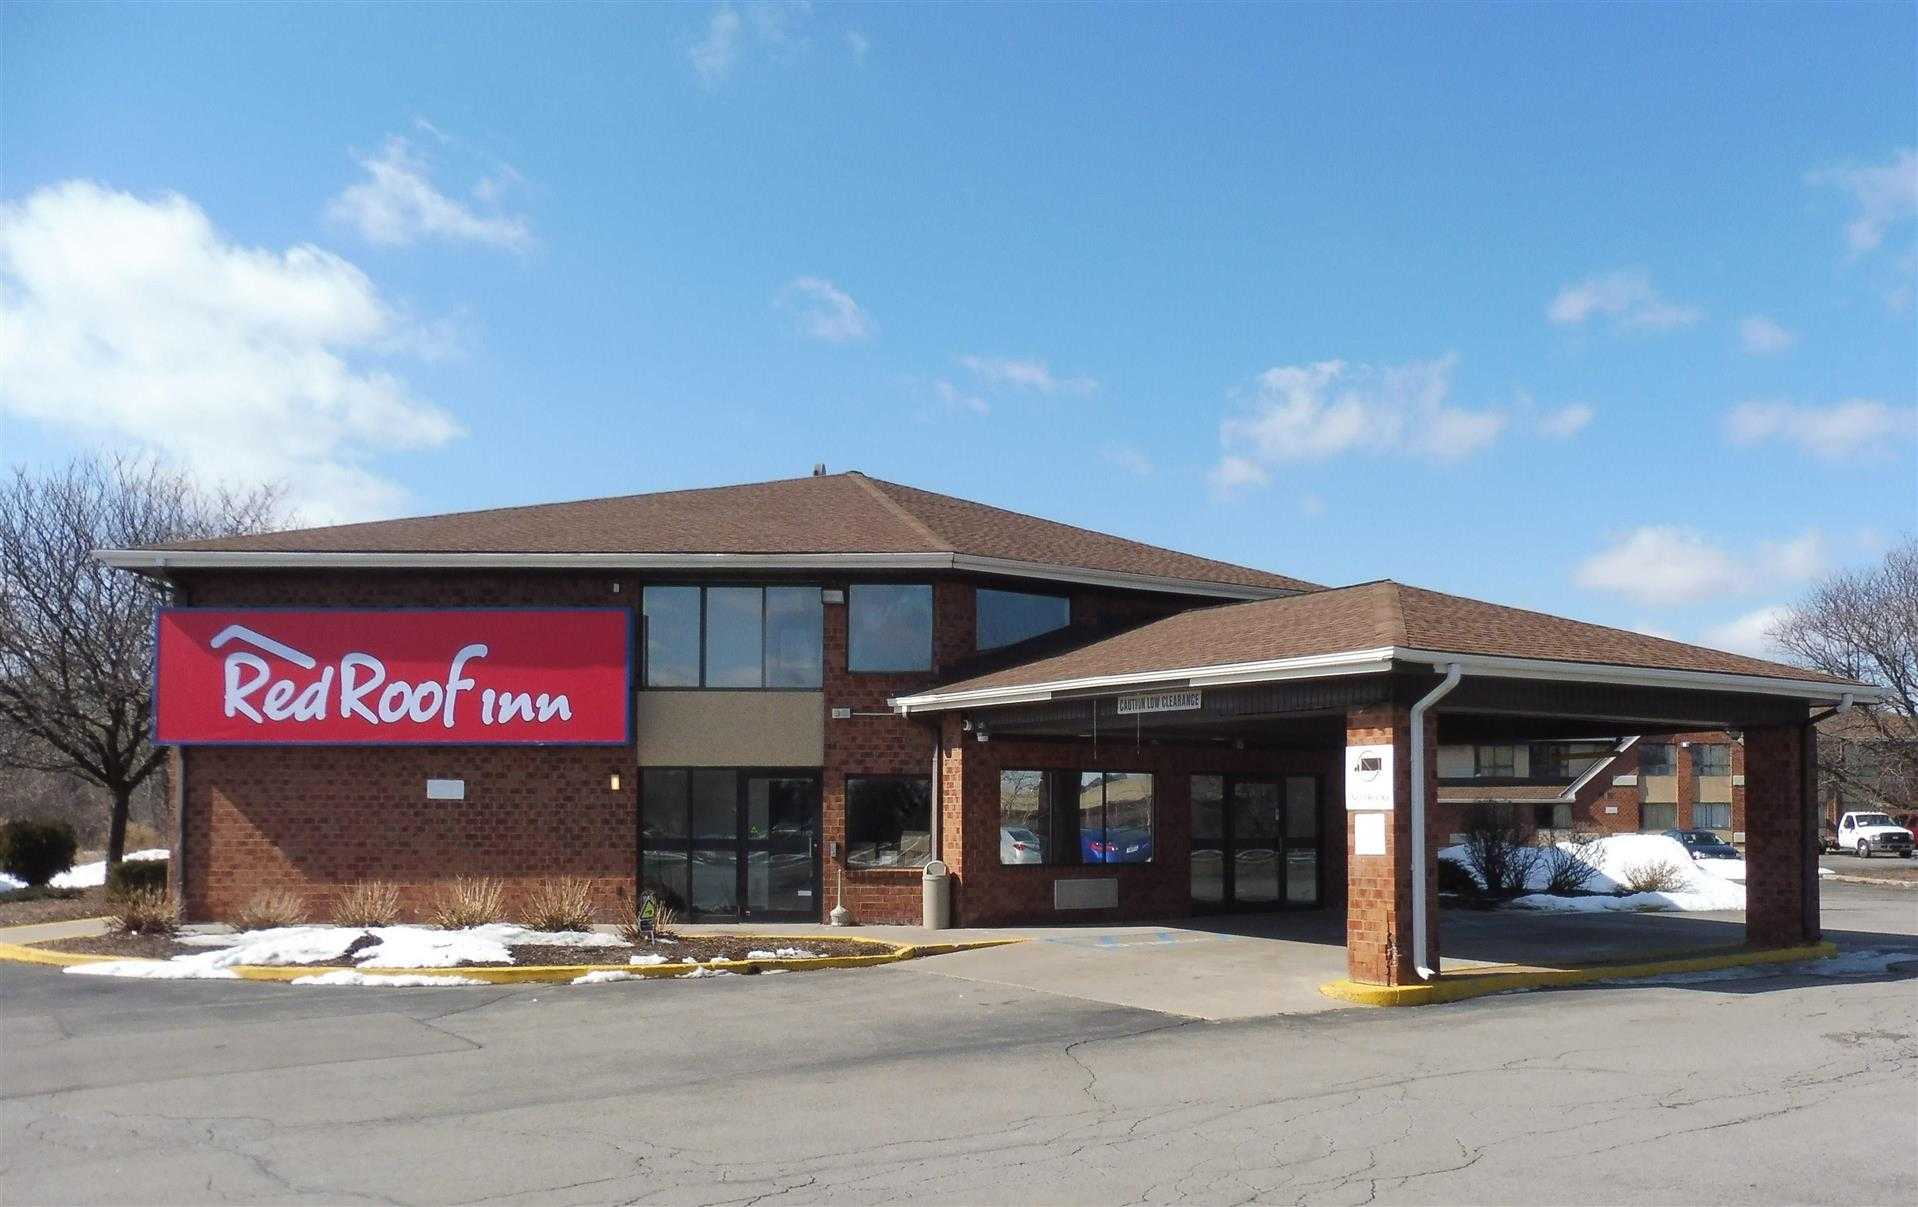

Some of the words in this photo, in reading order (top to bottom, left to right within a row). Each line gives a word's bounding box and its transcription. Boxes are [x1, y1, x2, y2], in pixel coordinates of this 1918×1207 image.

[223, 651, 335, 724] Red
[339, 643, 488, 728] Roof
[1119, 697, 1146, 711] CAUTION
[1147, 696, 1160, 709] LOW
[1161, 693, 1200, 708] CLEARANCE
